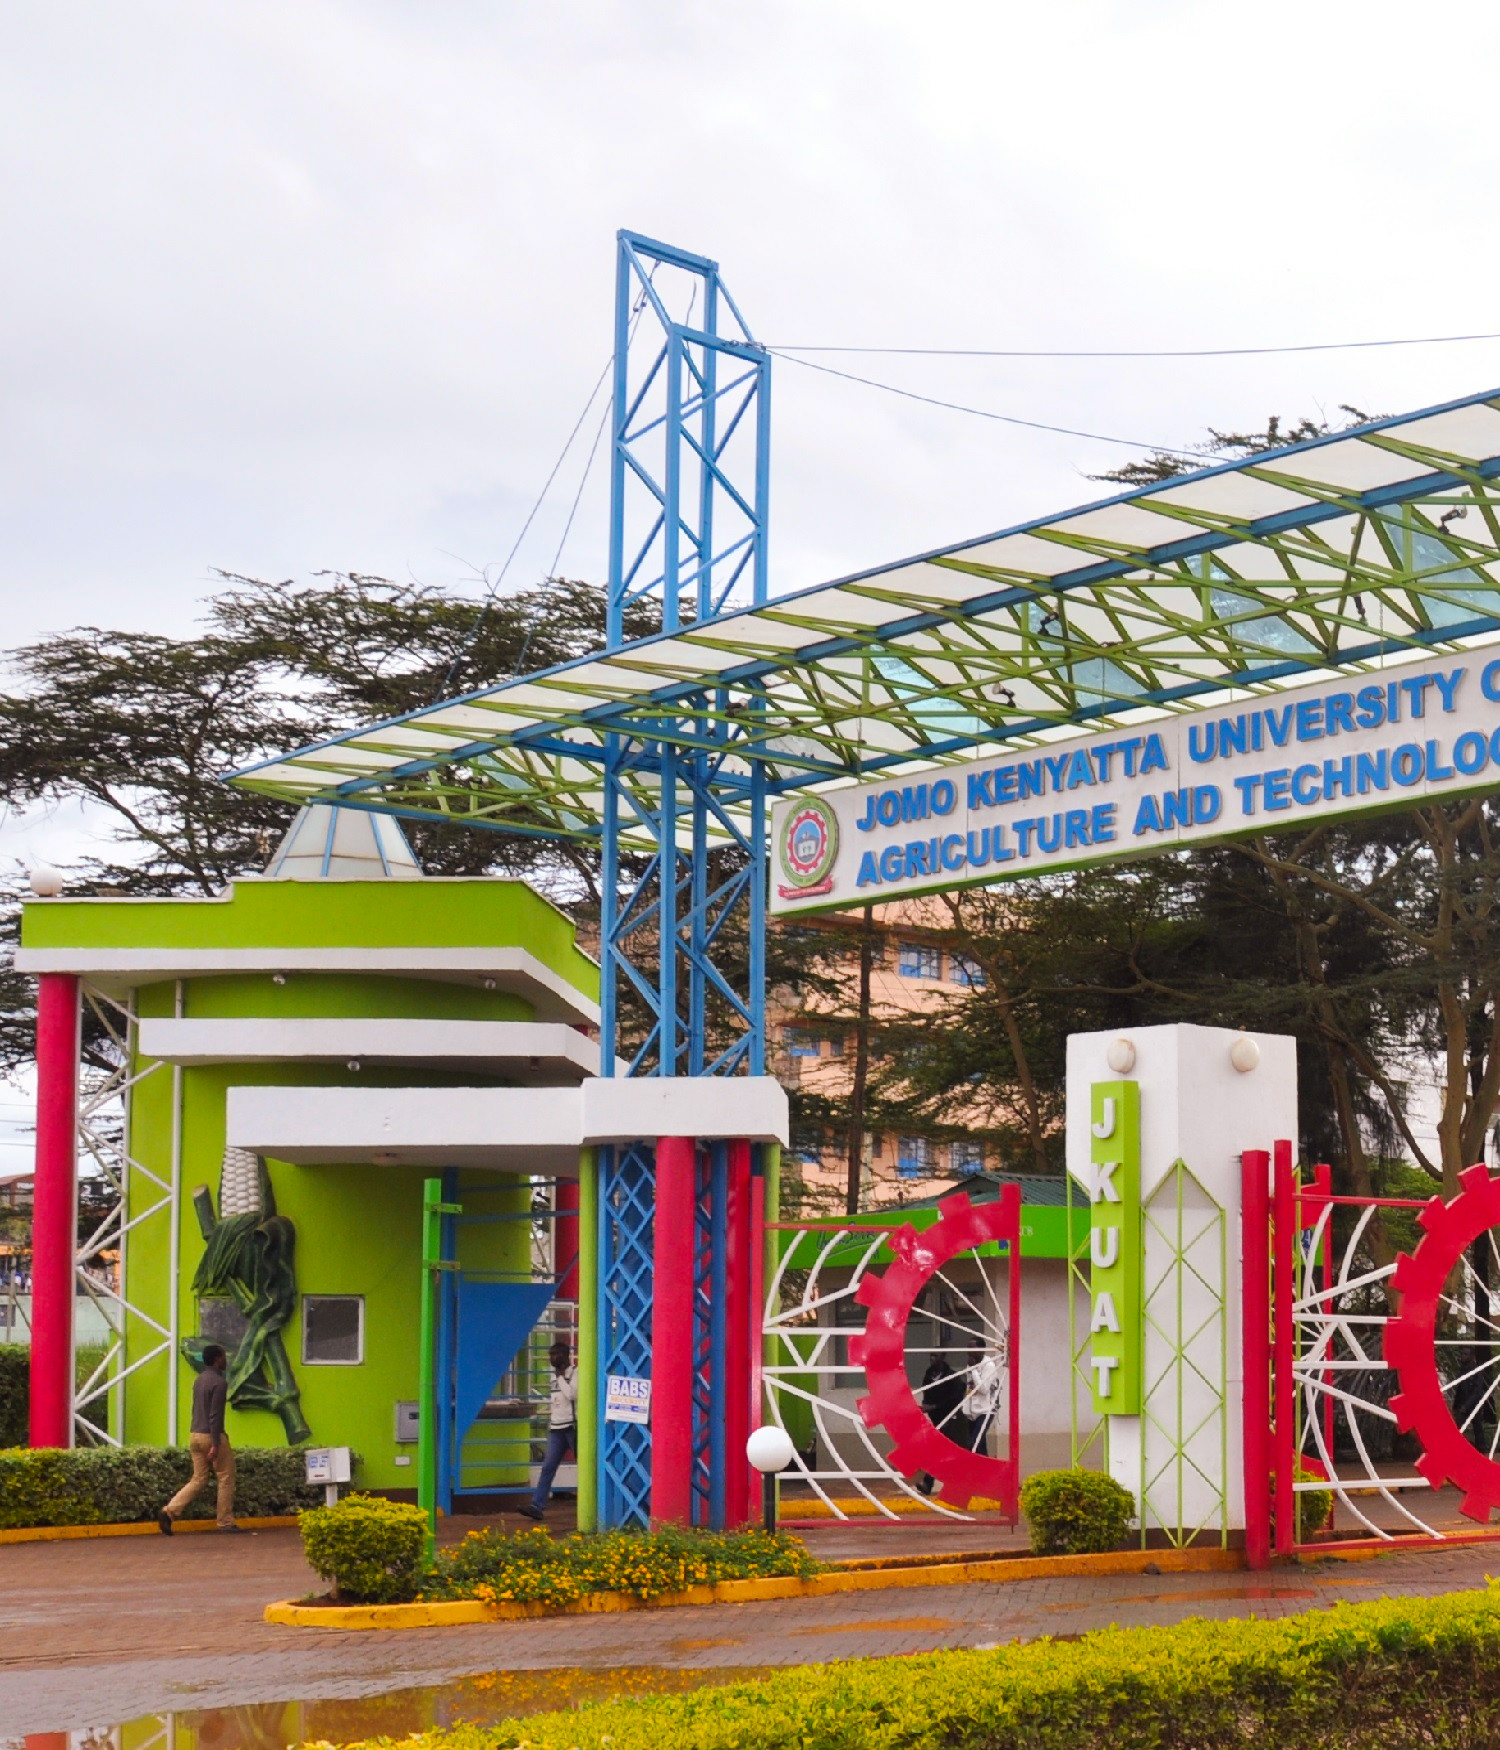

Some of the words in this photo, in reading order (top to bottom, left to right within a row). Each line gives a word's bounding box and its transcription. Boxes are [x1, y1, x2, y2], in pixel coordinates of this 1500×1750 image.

[856, 779, 956, 832] JOMO
[967, 734, 1167, 809] KENYATTA
[1189, 669, 1464, 763] UNIVERSITY
[856, 803, 1115, 887] AGRICULTURE
[1134, 785, 1222, 834] AND
[1090, 1096, 1121, 1399] JKUAT
[609, 1379, 649, 1399] BABS
